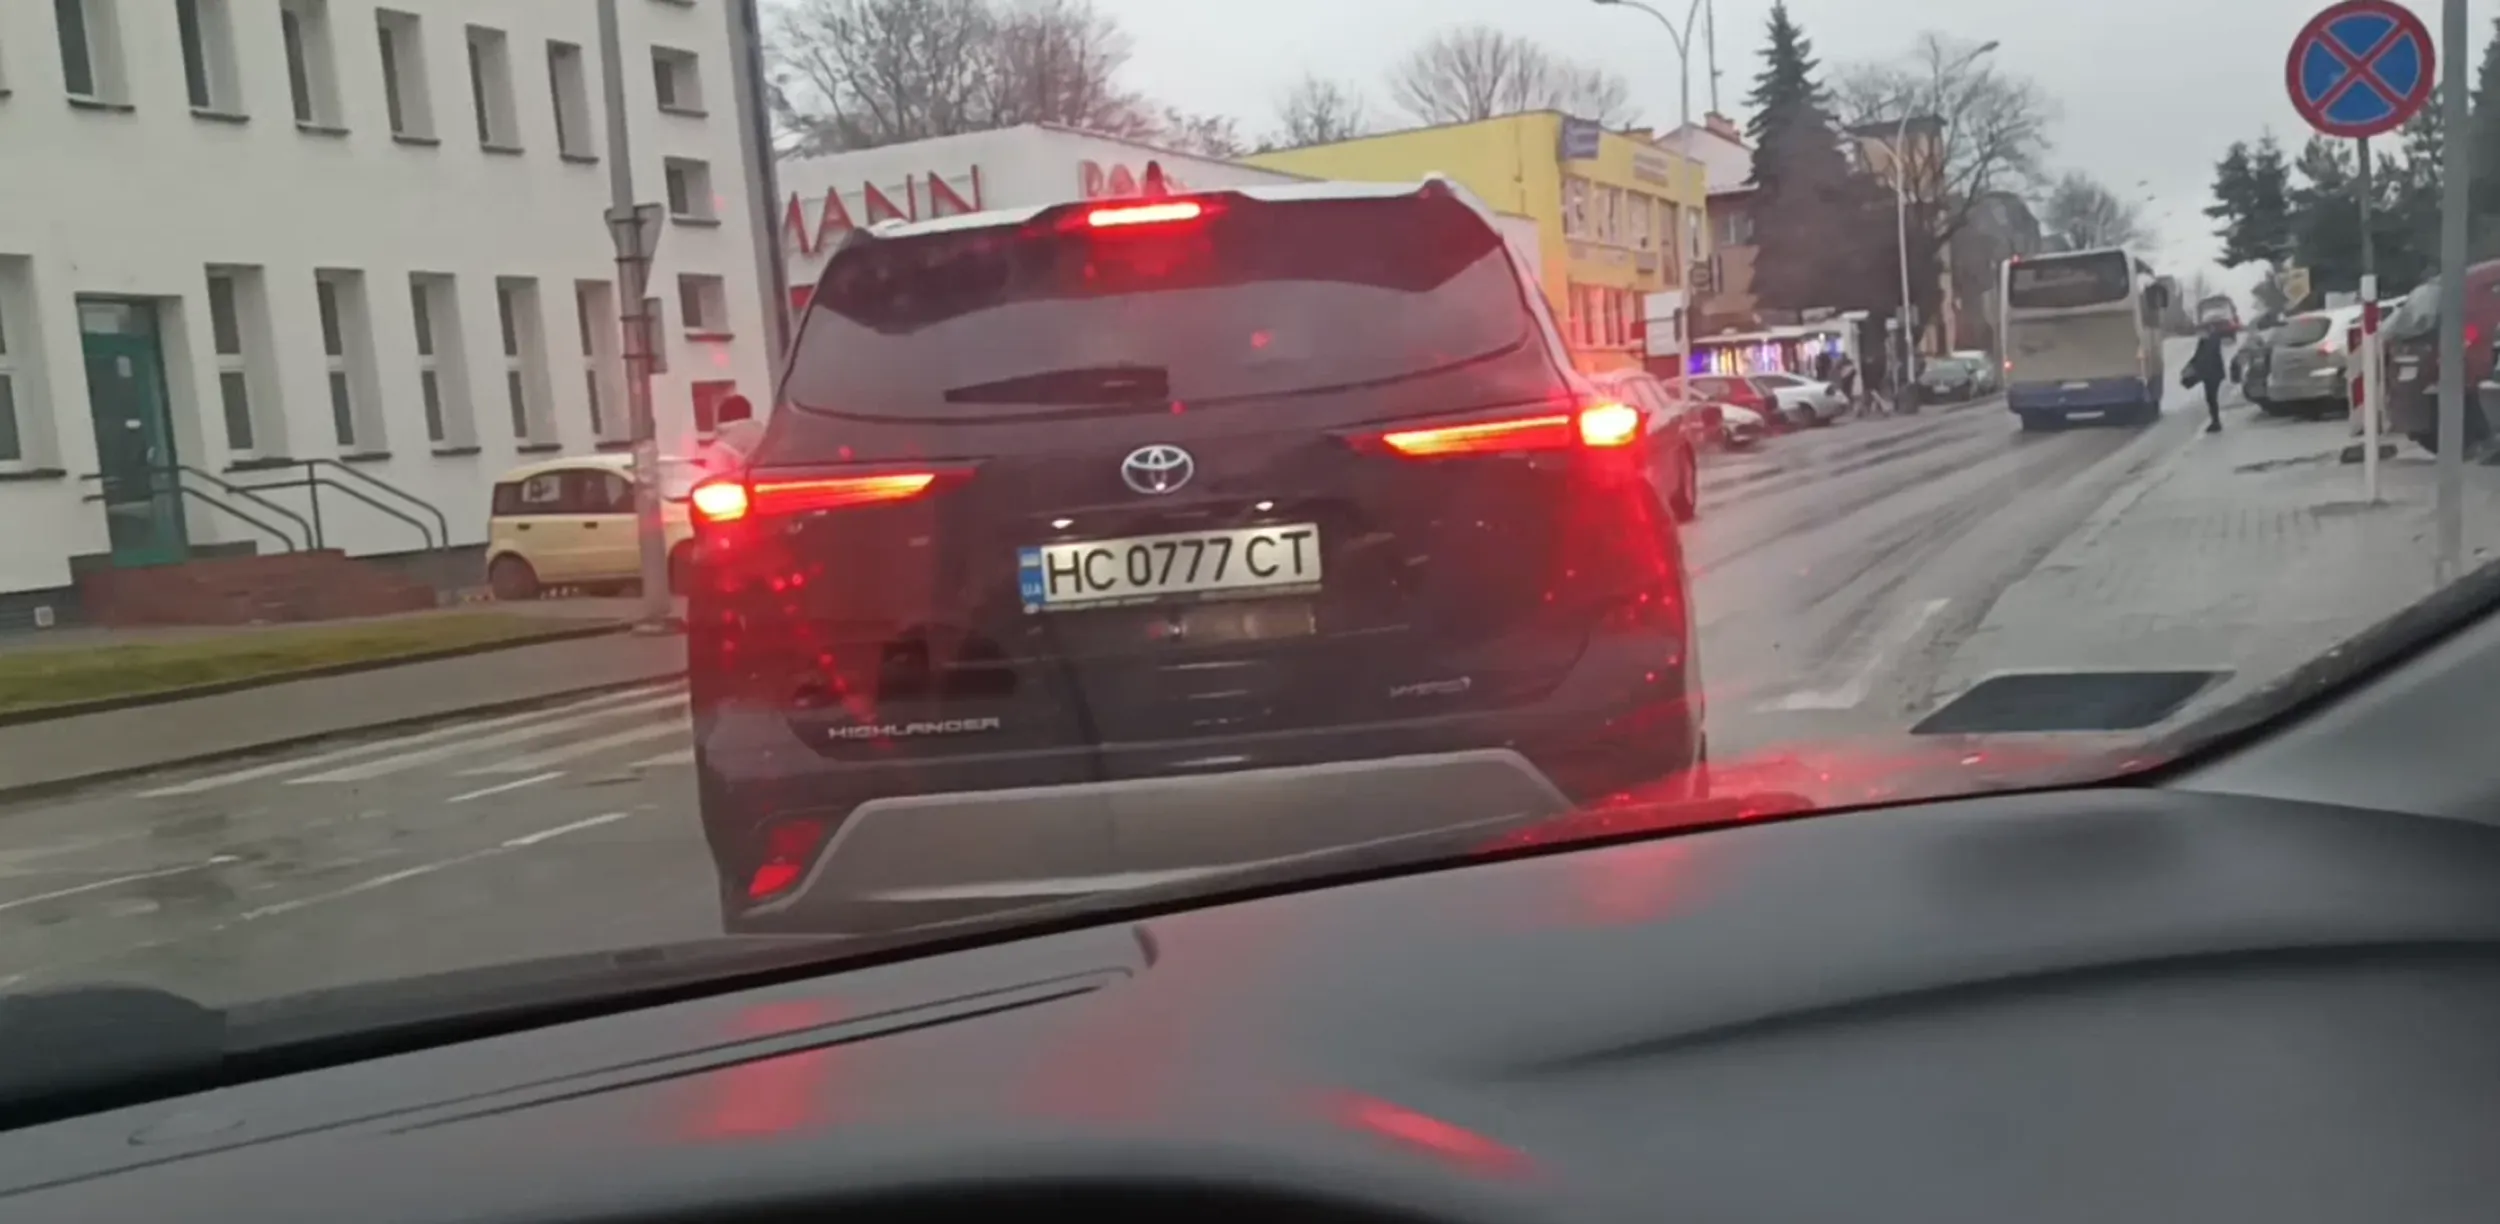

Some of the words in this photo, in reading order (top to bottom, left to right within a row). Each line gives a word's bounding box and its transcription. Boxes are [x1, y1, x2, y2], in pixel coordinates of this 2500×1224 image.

[1047, 548, 1117, 594] HC
[1126, 537, 1233, 587] 0777
[1245, 531, 1312, 577] CT
[1021, 582, 1042, 597] UA
[827, 717, 999, 739] HIGHLANDER
